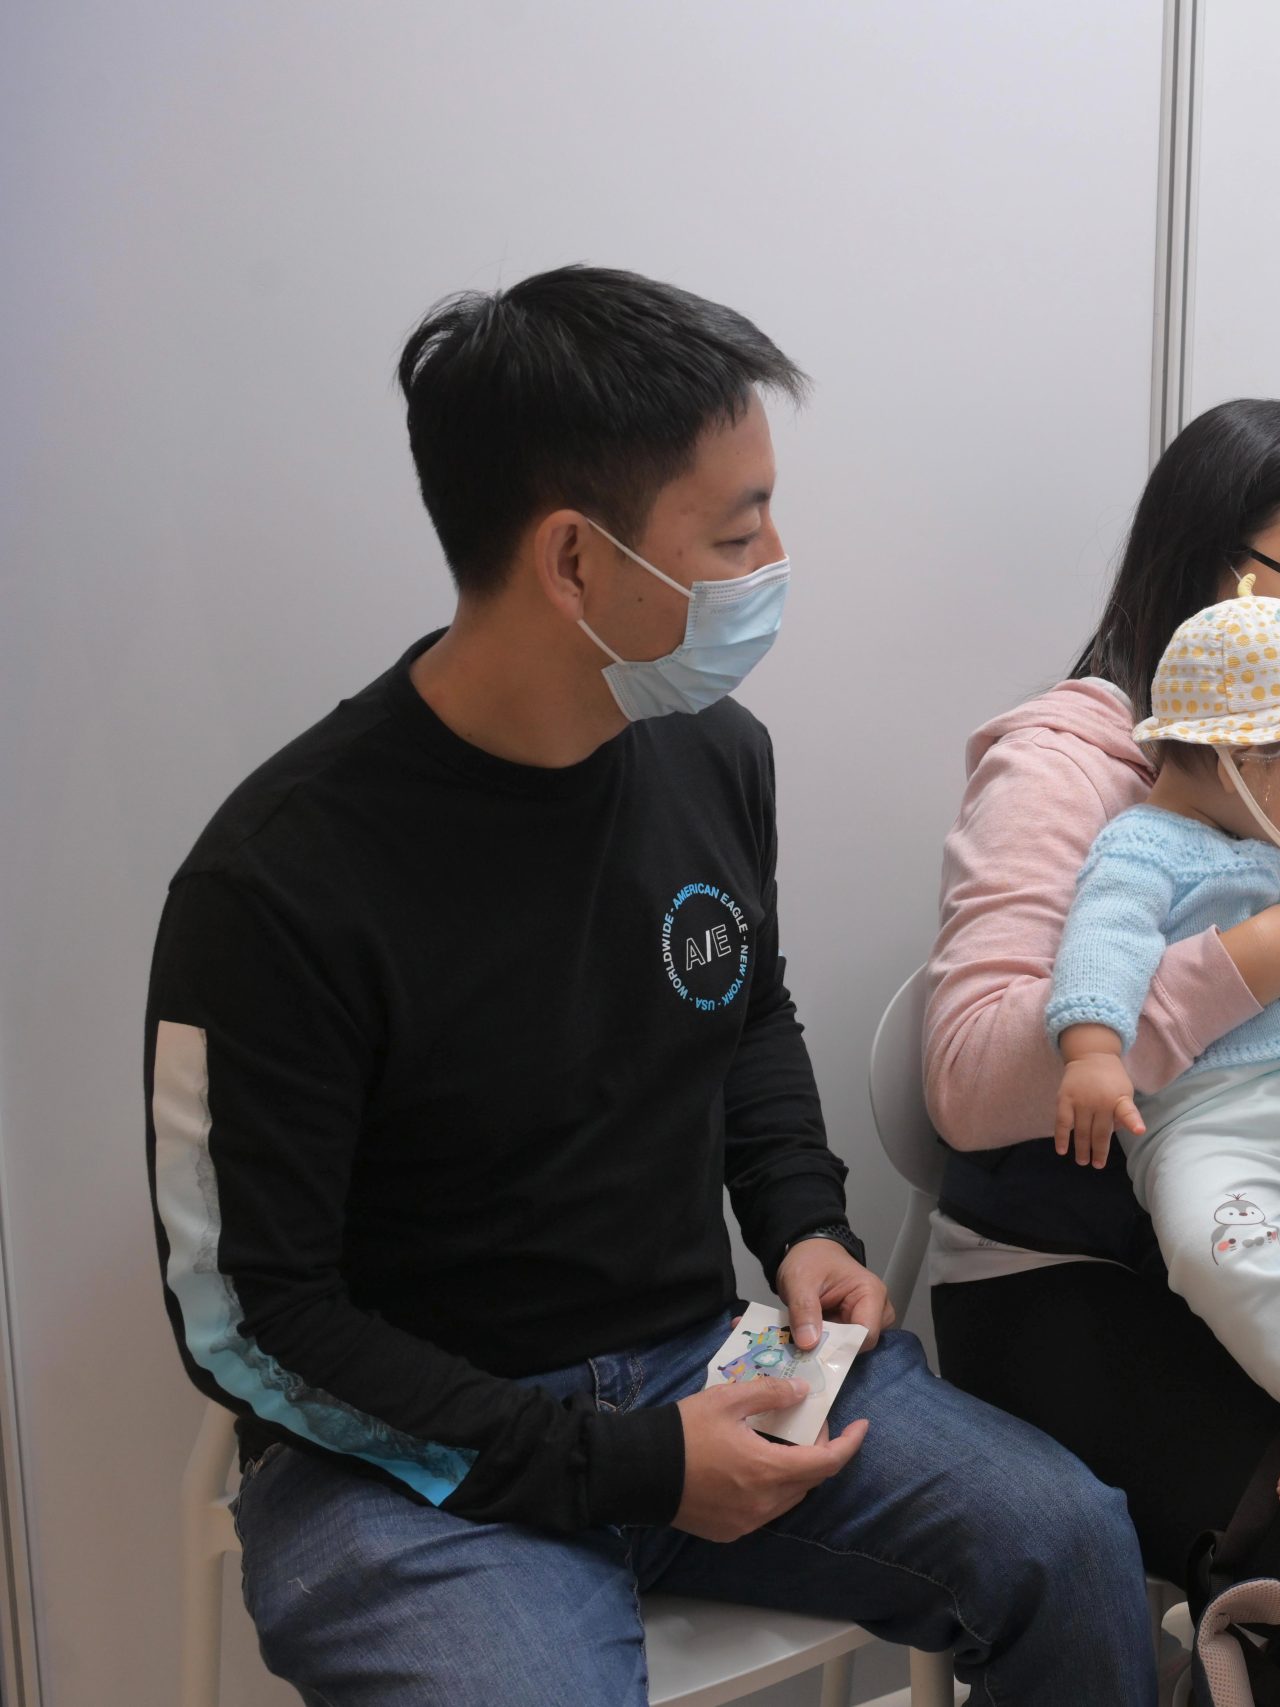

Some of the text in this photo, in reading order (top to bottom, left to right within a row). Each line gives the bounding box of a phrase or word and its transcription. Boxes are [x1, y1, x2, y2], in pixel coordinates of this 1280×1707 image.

[662, 883, 748, 1010] AMERICAN EAGLE NEW YORK USA WORLDWIDE
